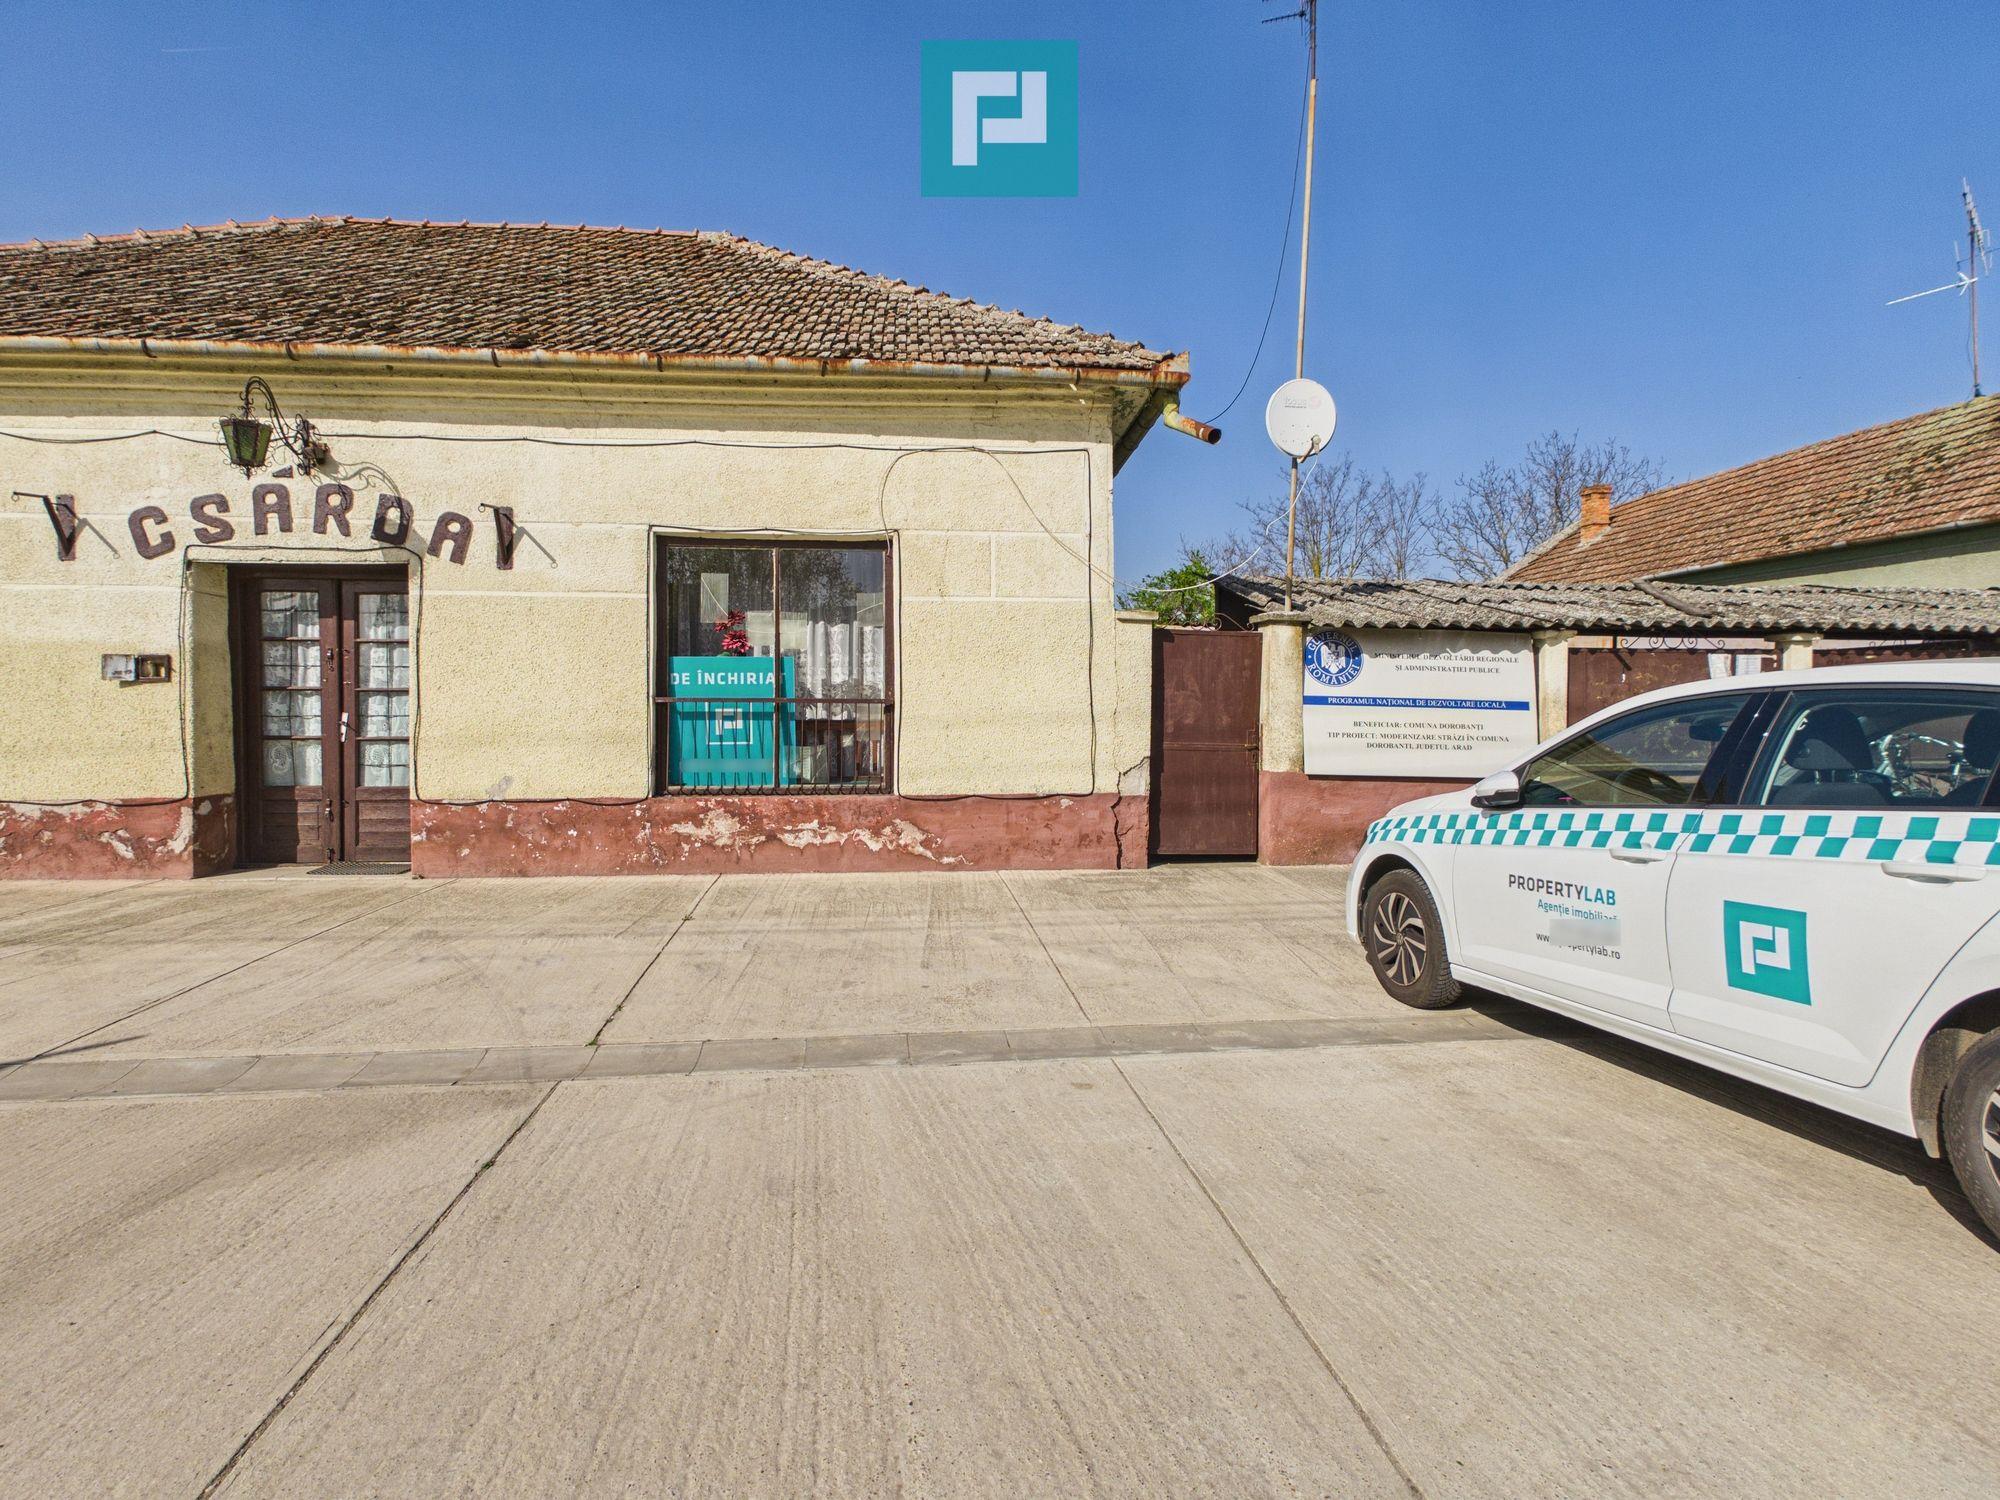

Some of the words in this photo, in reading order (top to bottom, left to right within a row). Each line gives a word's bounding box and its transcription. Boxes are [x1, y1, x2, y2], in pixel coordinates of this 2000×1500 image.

[127, 465, 474, 566] CSÁRDA
[1477, 655, 1520, 664] REGIONALE
[670, 672, 690, 685] DE
[1328, 697, 1375, 705] PROGRAMUL
[1427, 700, 1476, 708] DEZVOLTARE
[1508, 874, 1616, 906] PROPERTYLAB
